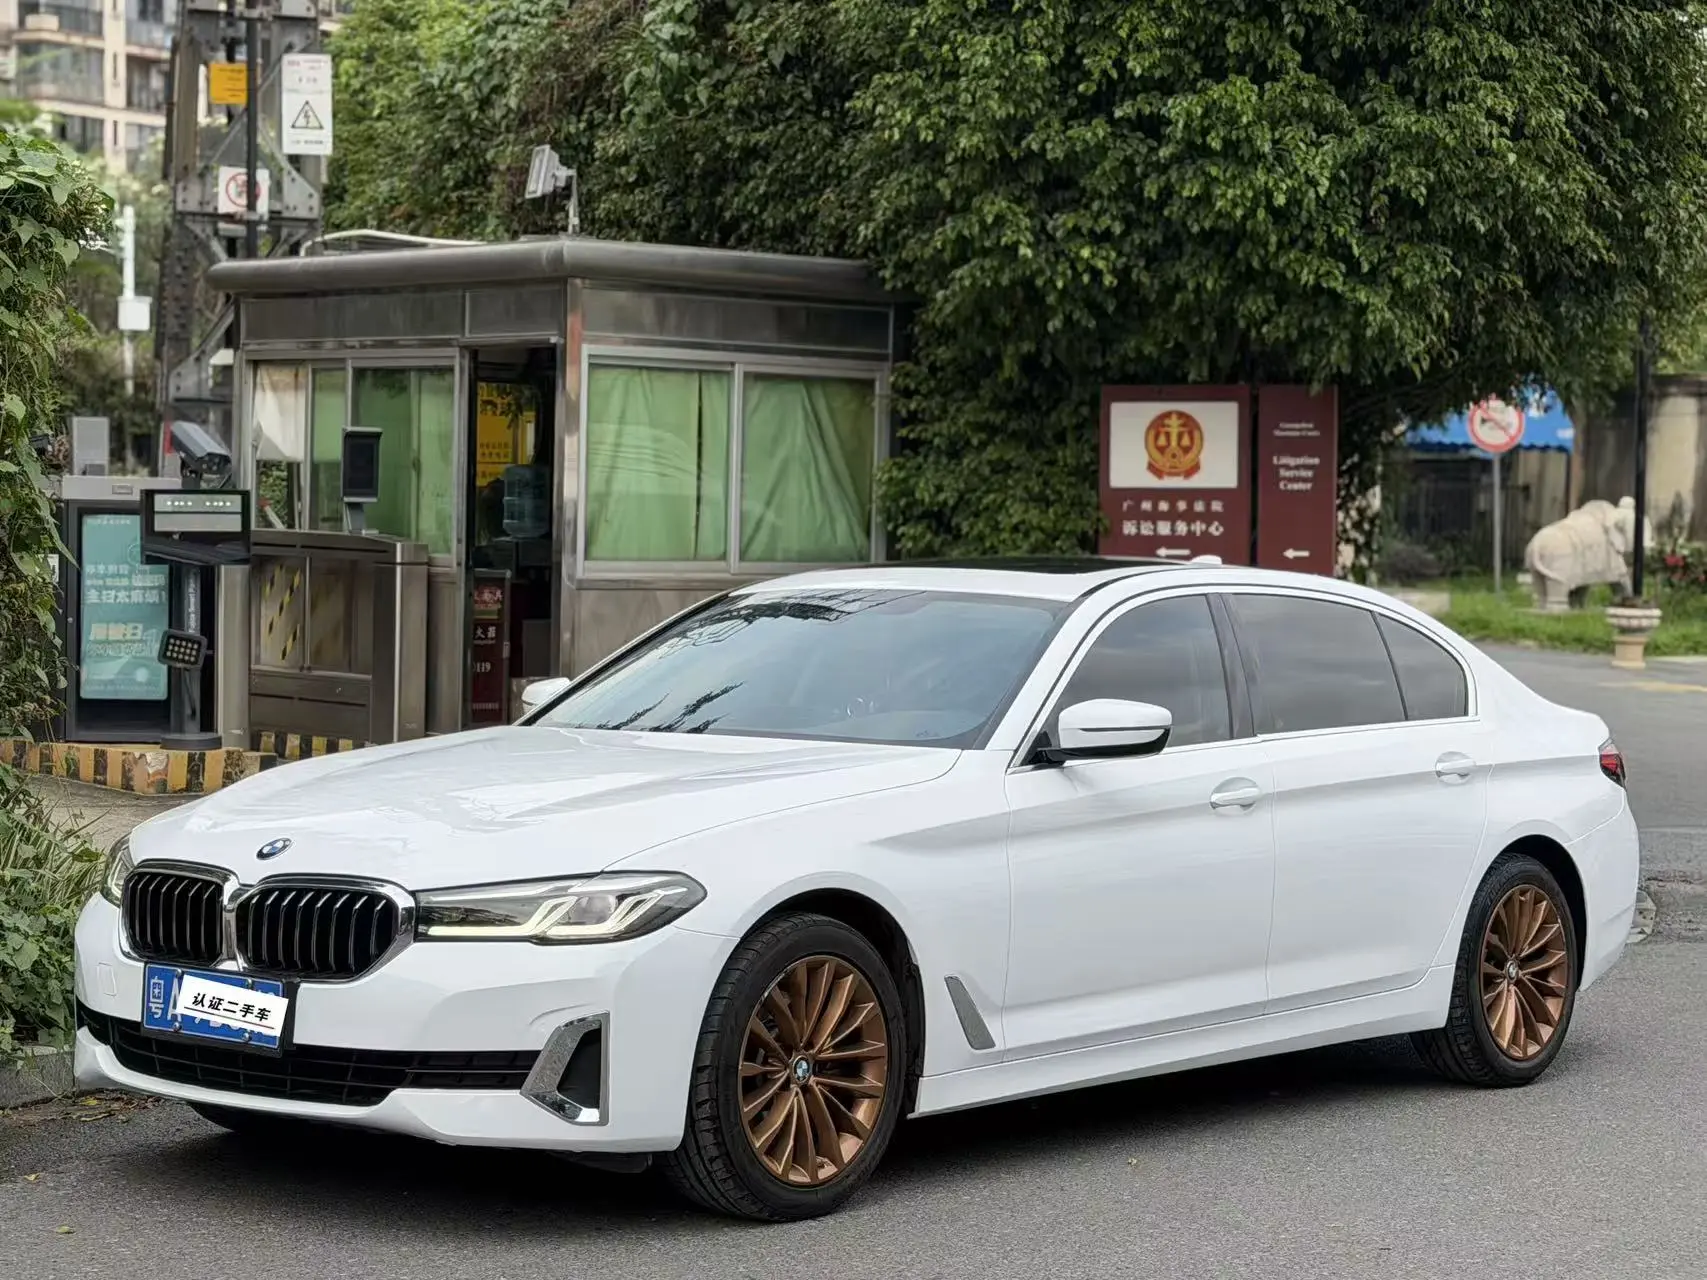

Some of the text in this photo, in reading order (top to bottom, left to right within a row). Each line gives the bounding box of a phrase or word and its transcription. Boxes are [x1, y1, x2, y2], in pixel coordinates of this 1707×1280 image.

[1272, 455, 1320, 467] Litigation
[1279, 469, 1314, 478] Service
[1279, 481, 1312, 491] Center
[1122, 520, 1224, 537] 诉讼服务中心
